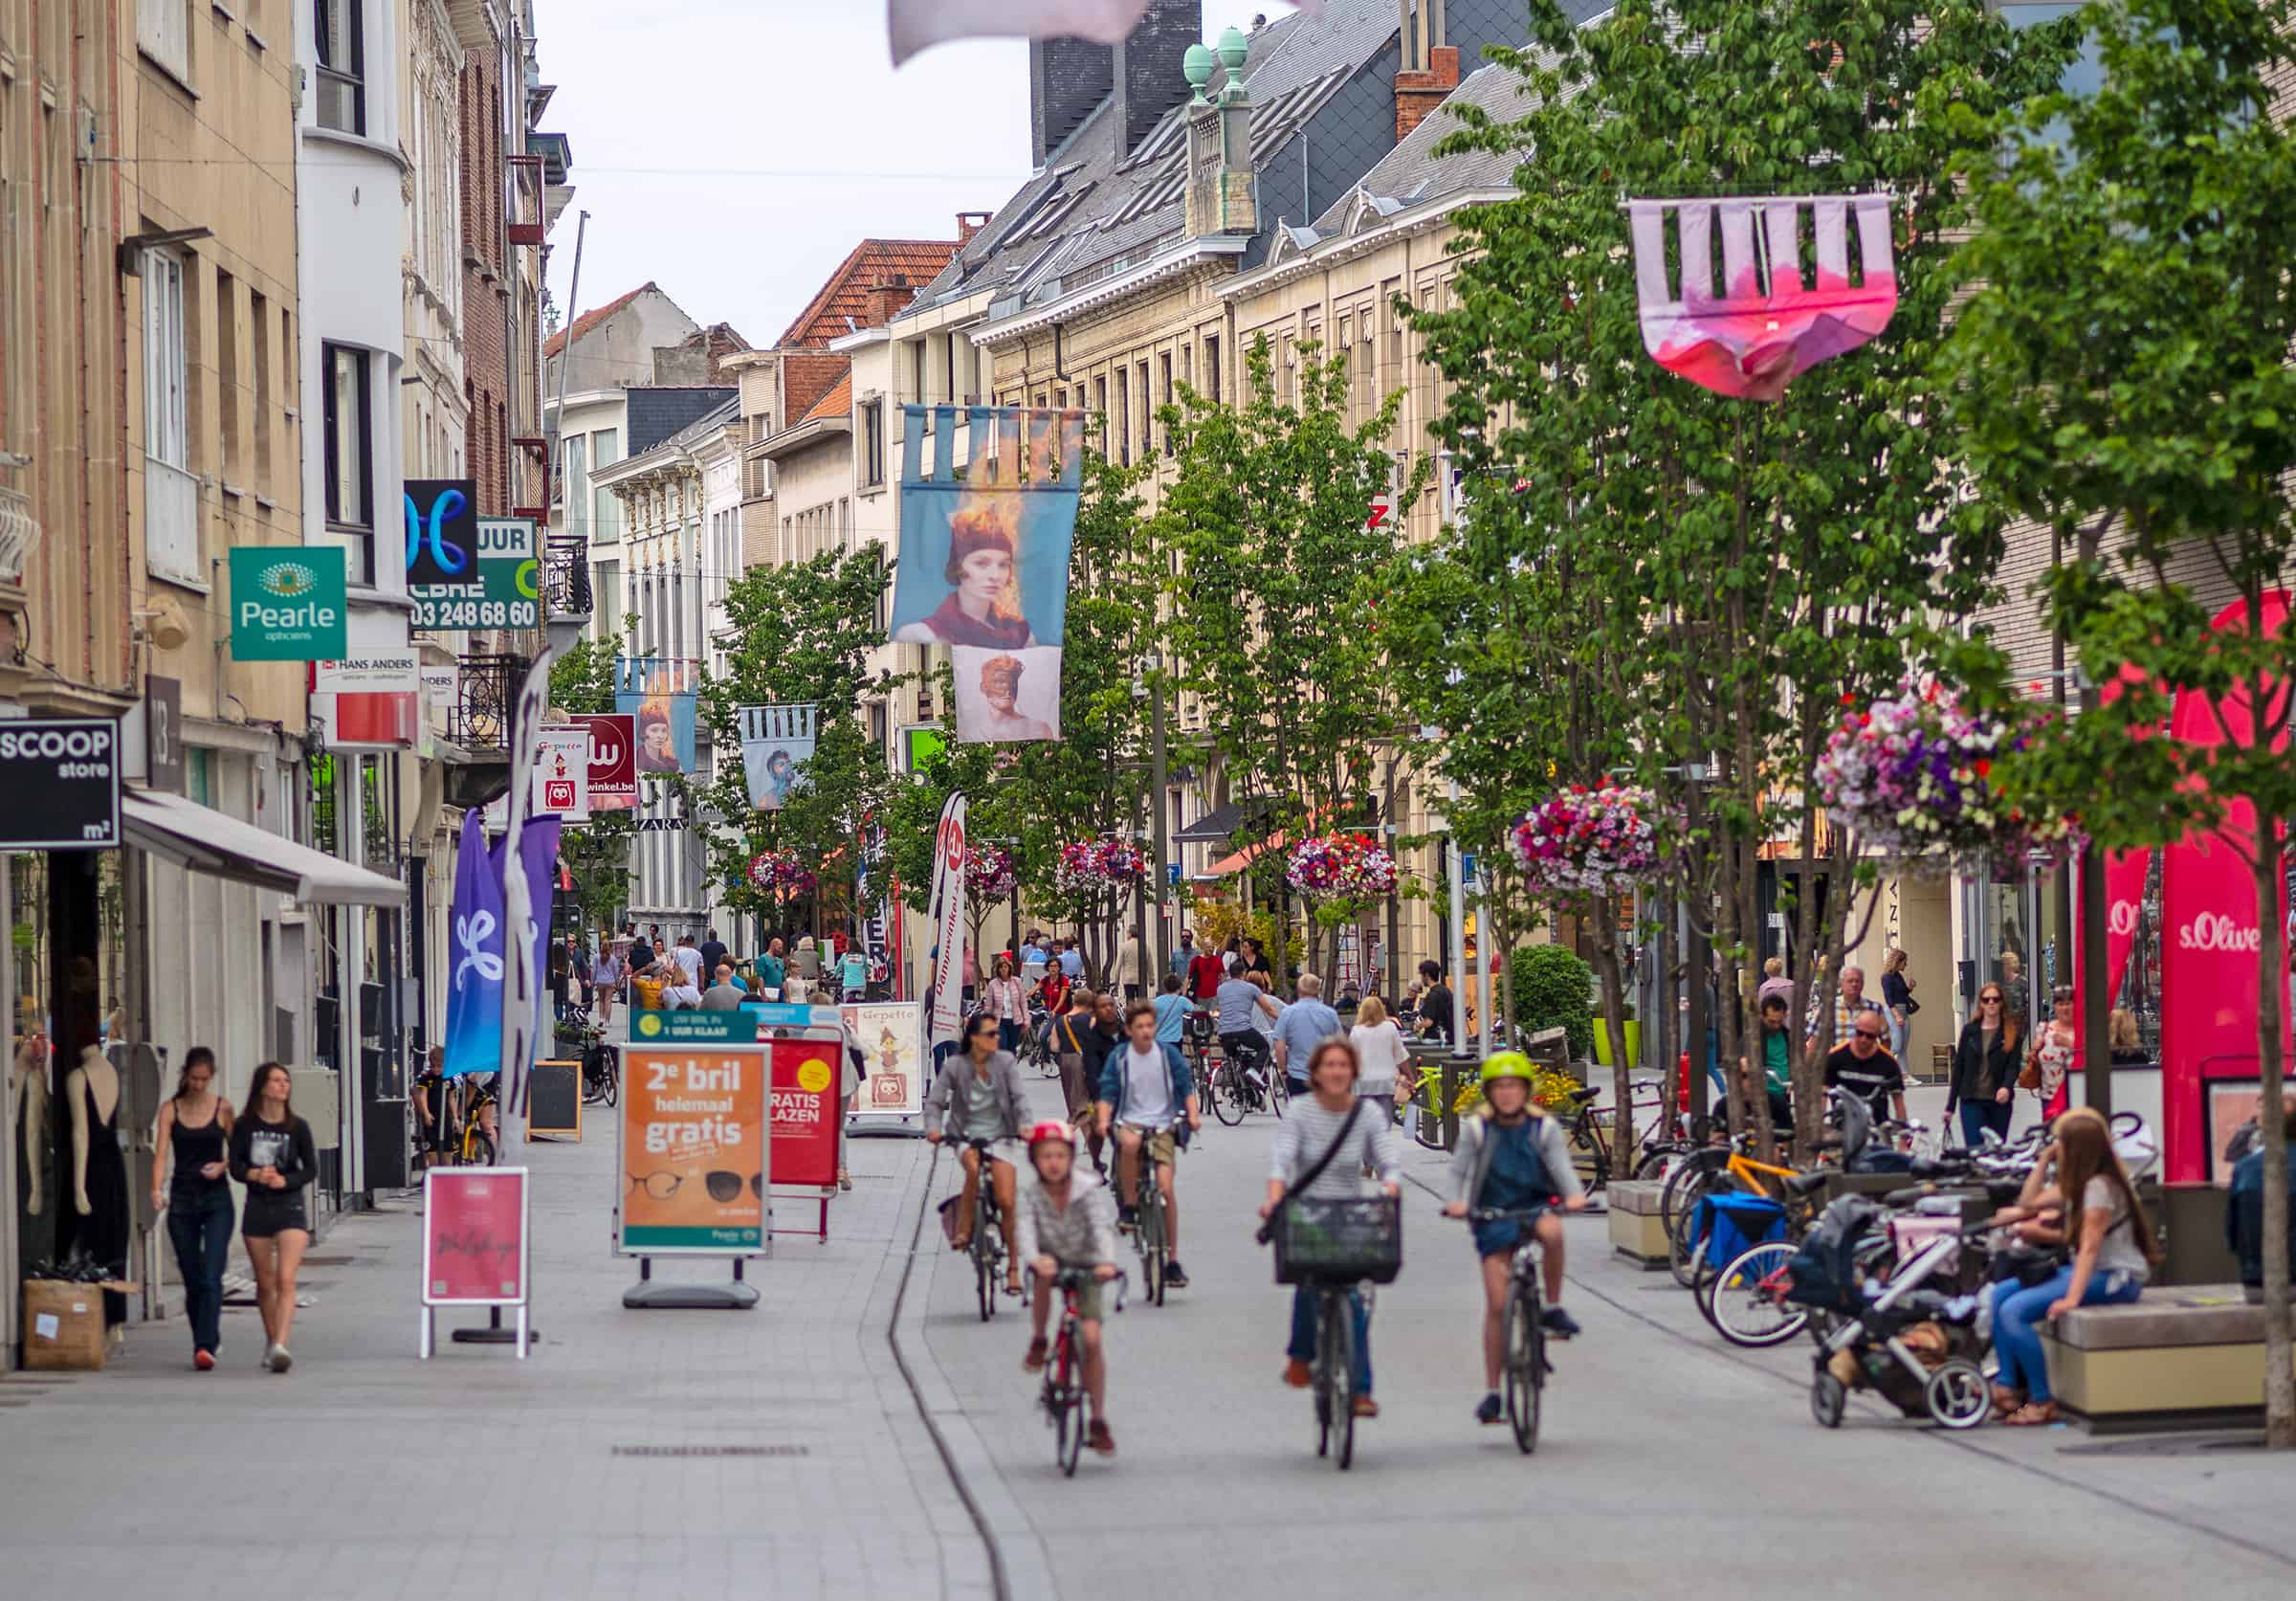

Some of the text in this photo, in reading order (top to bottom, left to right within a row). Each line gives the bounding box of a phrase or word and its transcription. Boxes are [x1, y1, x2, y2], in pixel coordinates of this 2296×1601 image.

[477, 527, 525, 551] UUR
[240, 601, 335, 628] Pearle
[409, 601, 536, 626] 03 248 68 60
[339, 658, 414, 670] HANS ANDERS
[0, 729, 110, 759] SCOOP
[57, 762, 110, 779] store
[587, 782, 635, 792] winkel.be
[638, 817, 684, 831] ZARA
[2179, 910, 2262, 952] s.Olive
[685, 1059, 741, 1091] bril
[654, 1096, 734, 1113] helemaal
[769, 1093, 821, 1108] RATIS
[645, 1114, 742, 1152] gratis
